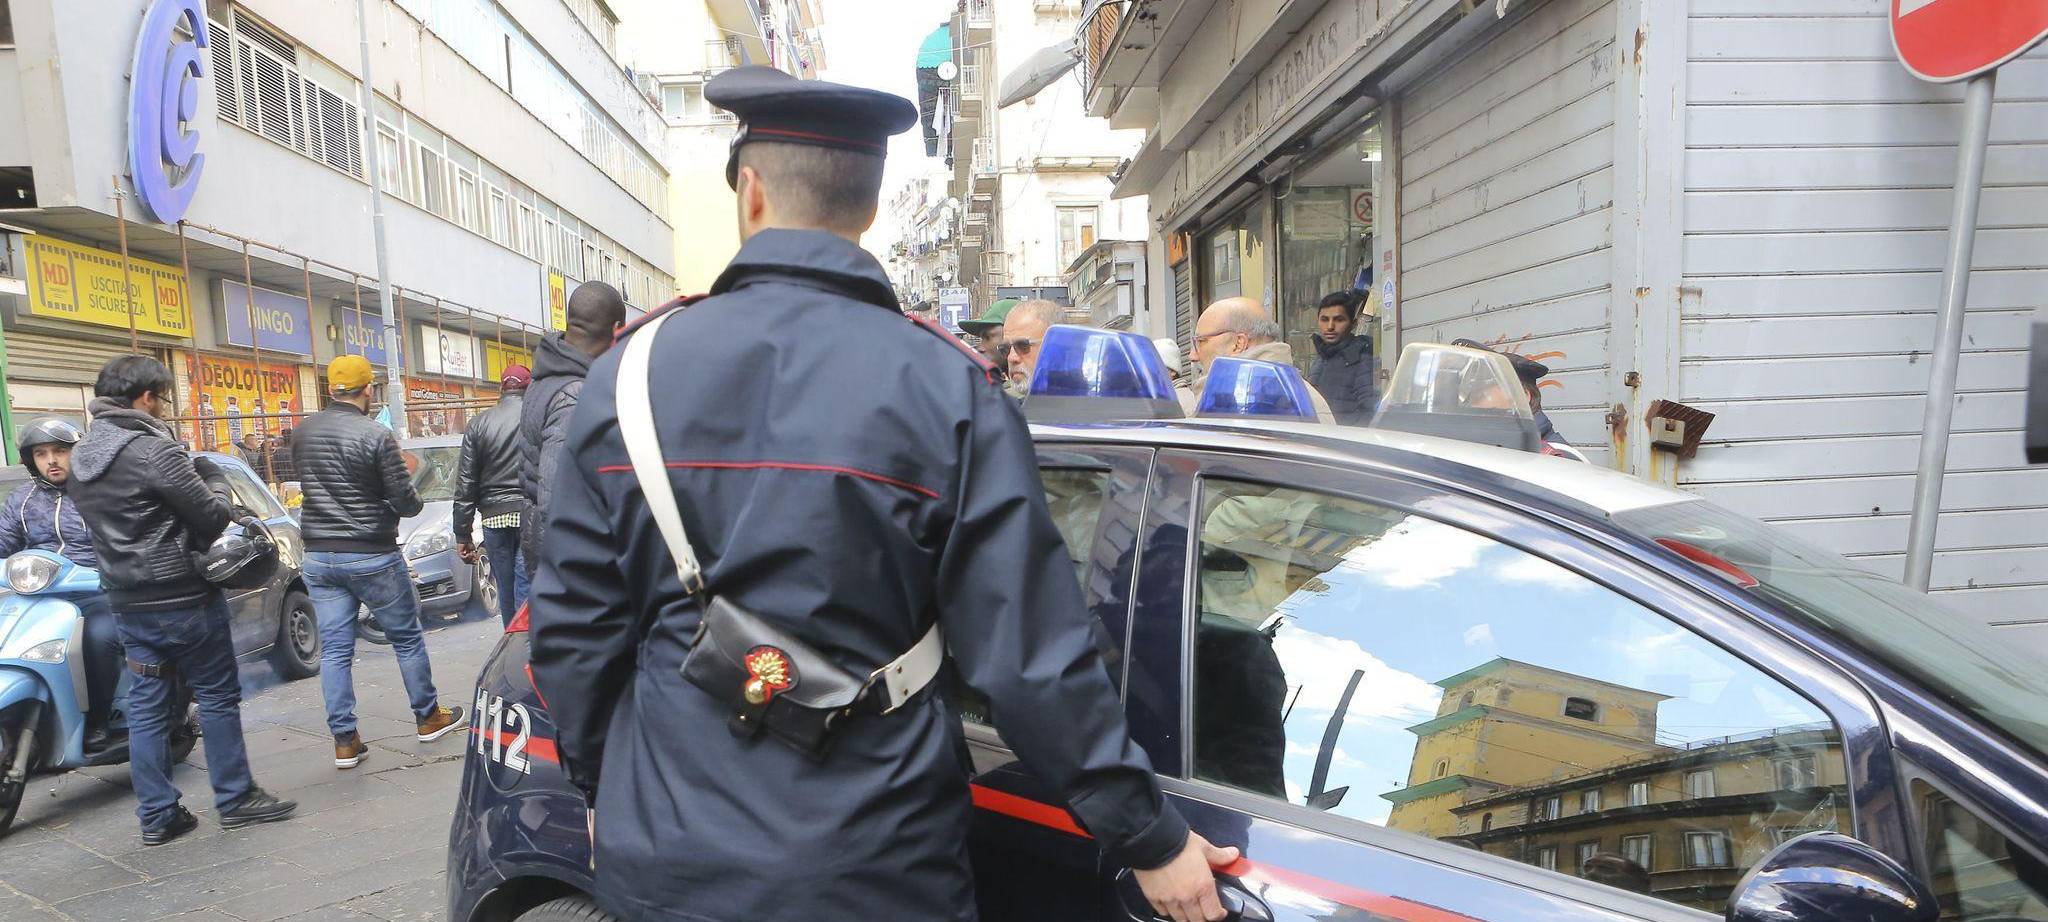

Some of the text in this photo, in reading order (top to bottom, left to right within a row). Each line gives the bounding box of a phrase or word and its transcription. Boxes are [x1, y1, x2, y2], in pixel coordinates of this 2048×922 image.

[42, 261, 69, 286] MD
[90, 275, 141, 298] USCITA DI
[158, 286, 179, 307] MD
[551, 285, 564, 310] MD
[941, 289, 968, 297] BAR
[88, 294, 147, 317] SICUREZA
[476, 686, 531, 774] 112
